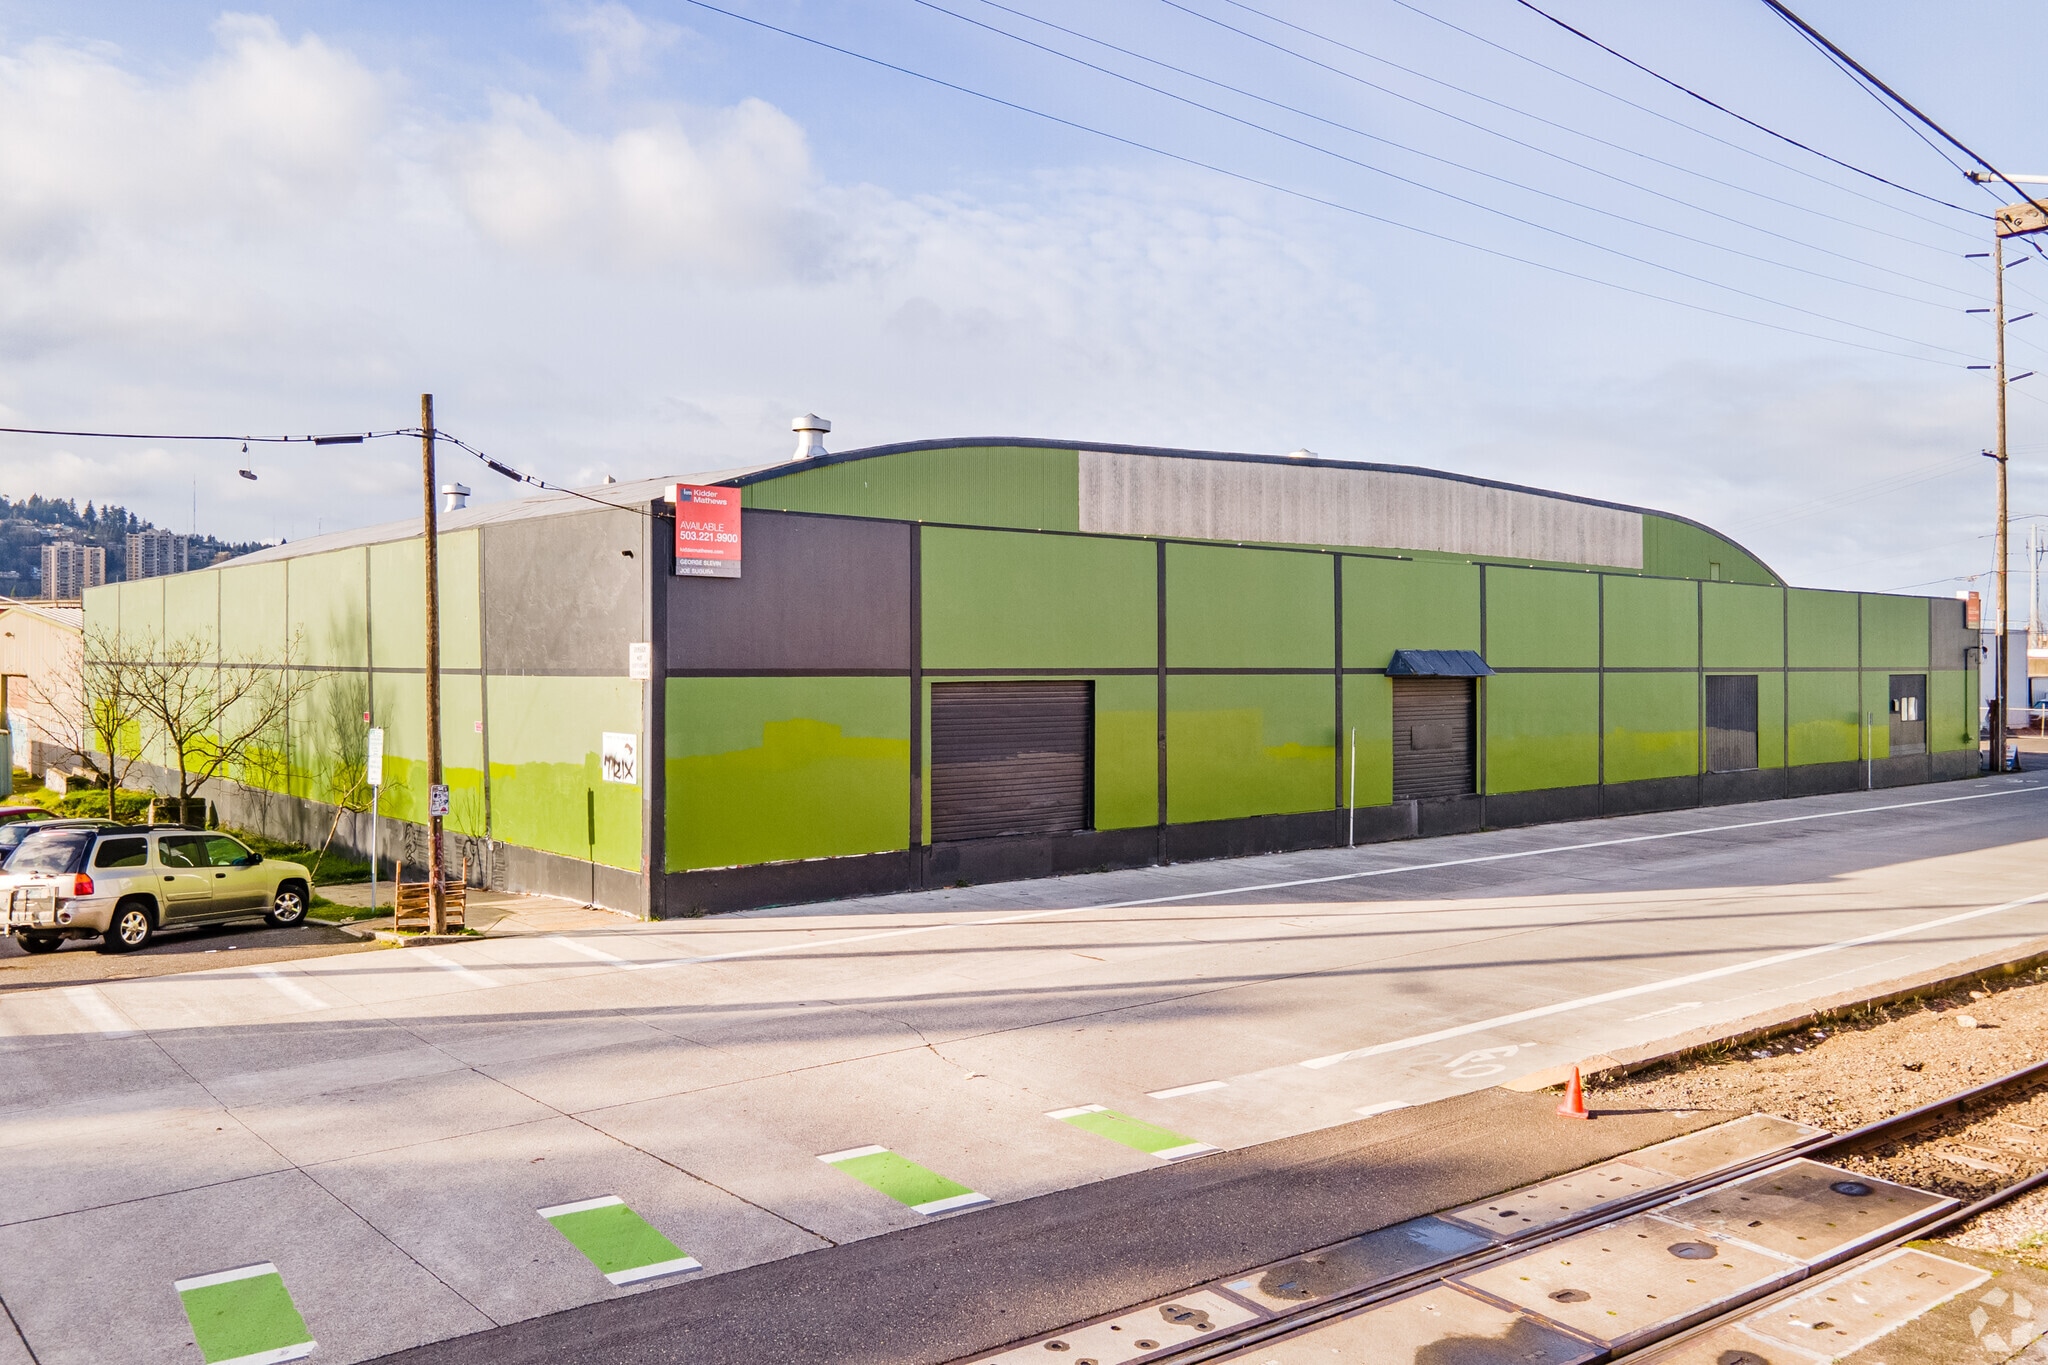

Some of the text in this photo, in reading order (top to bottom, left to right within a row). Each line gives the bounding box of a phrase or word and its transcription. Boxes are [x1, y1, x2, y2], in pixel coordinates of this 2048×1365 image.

[694, 489, 718, 497] Kidder
[694, 497, 727, 505] Mathews
[680, 521, 724, 532] AVAILABLE
[680, 531, 738, 542] 503.221.9900
